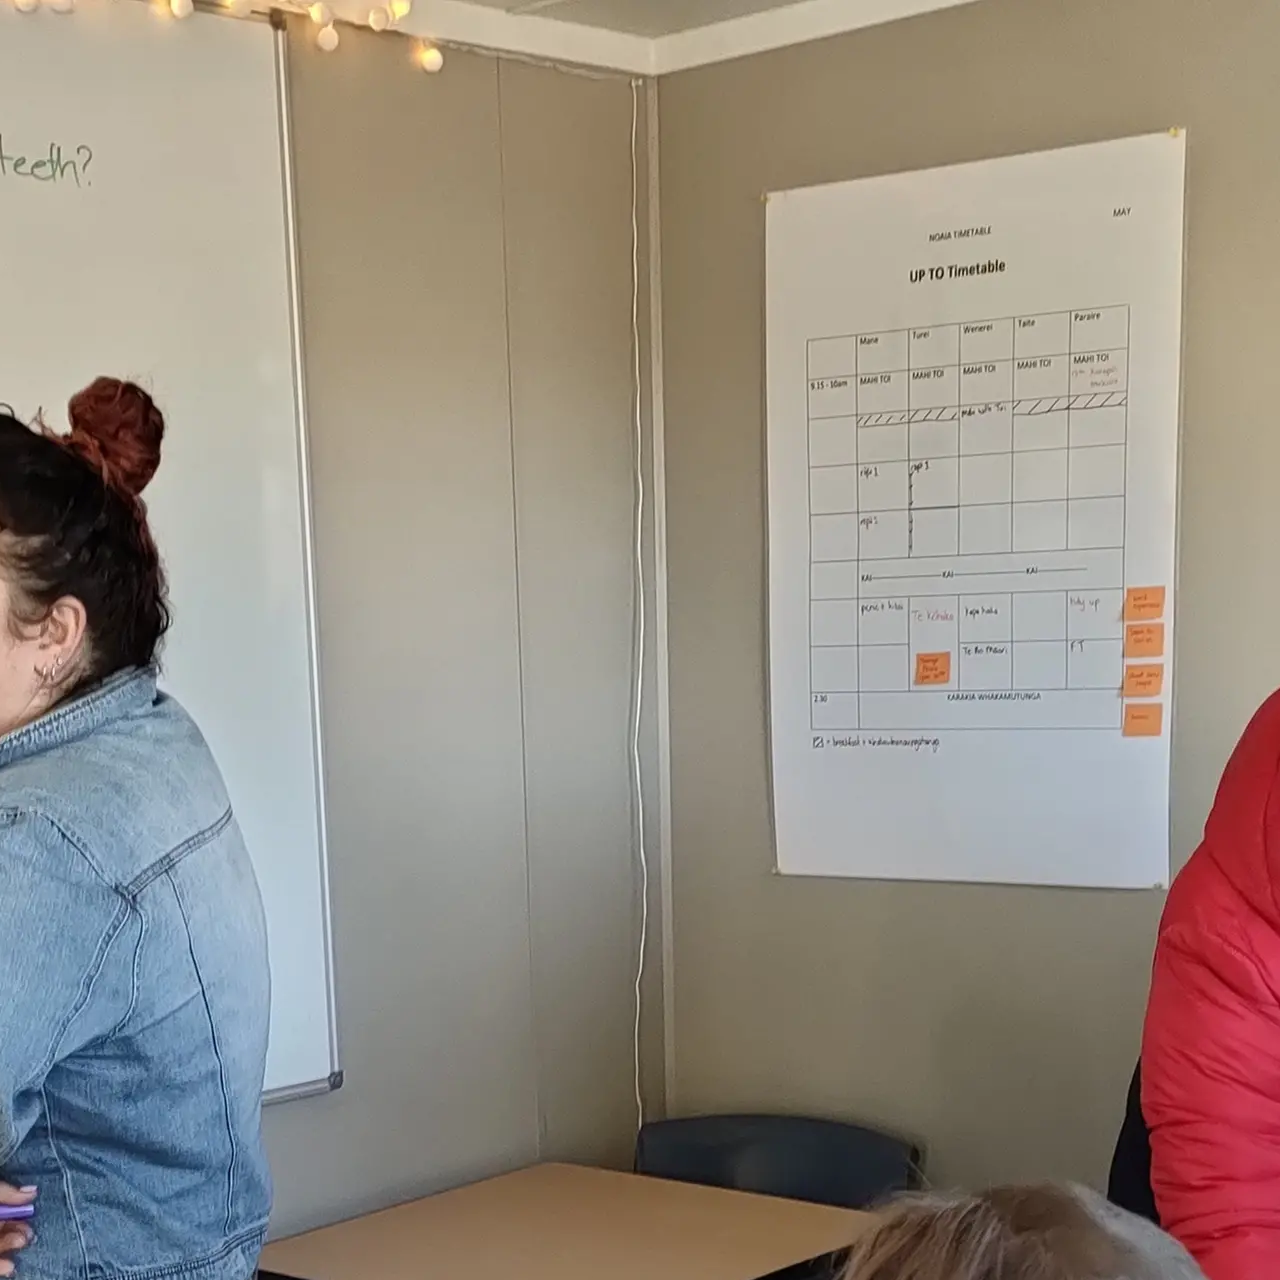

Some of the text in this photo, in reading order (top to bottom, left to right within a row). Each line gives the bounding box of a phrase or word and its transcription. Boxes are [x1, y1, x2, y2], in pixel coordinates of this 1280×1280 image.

[1113, 207, 1132, 218] MAY
[954, 225, 993, 240] TIMETABLE
[909, 259, 1007, 283] UP TO Timetable
[859, 312, 1101, 345] Mane Turei Wenerei Taite Paraire
[1017, 359, 1052, 370] MAHI TOI
[1073, 353, 1109, 364] MAHI TOI
[912, 369, 945, 381] MAHI TOI
[963, 365, 996, 375] MAHI TOI
[859, 374, 892, 386] MAHI TOI
